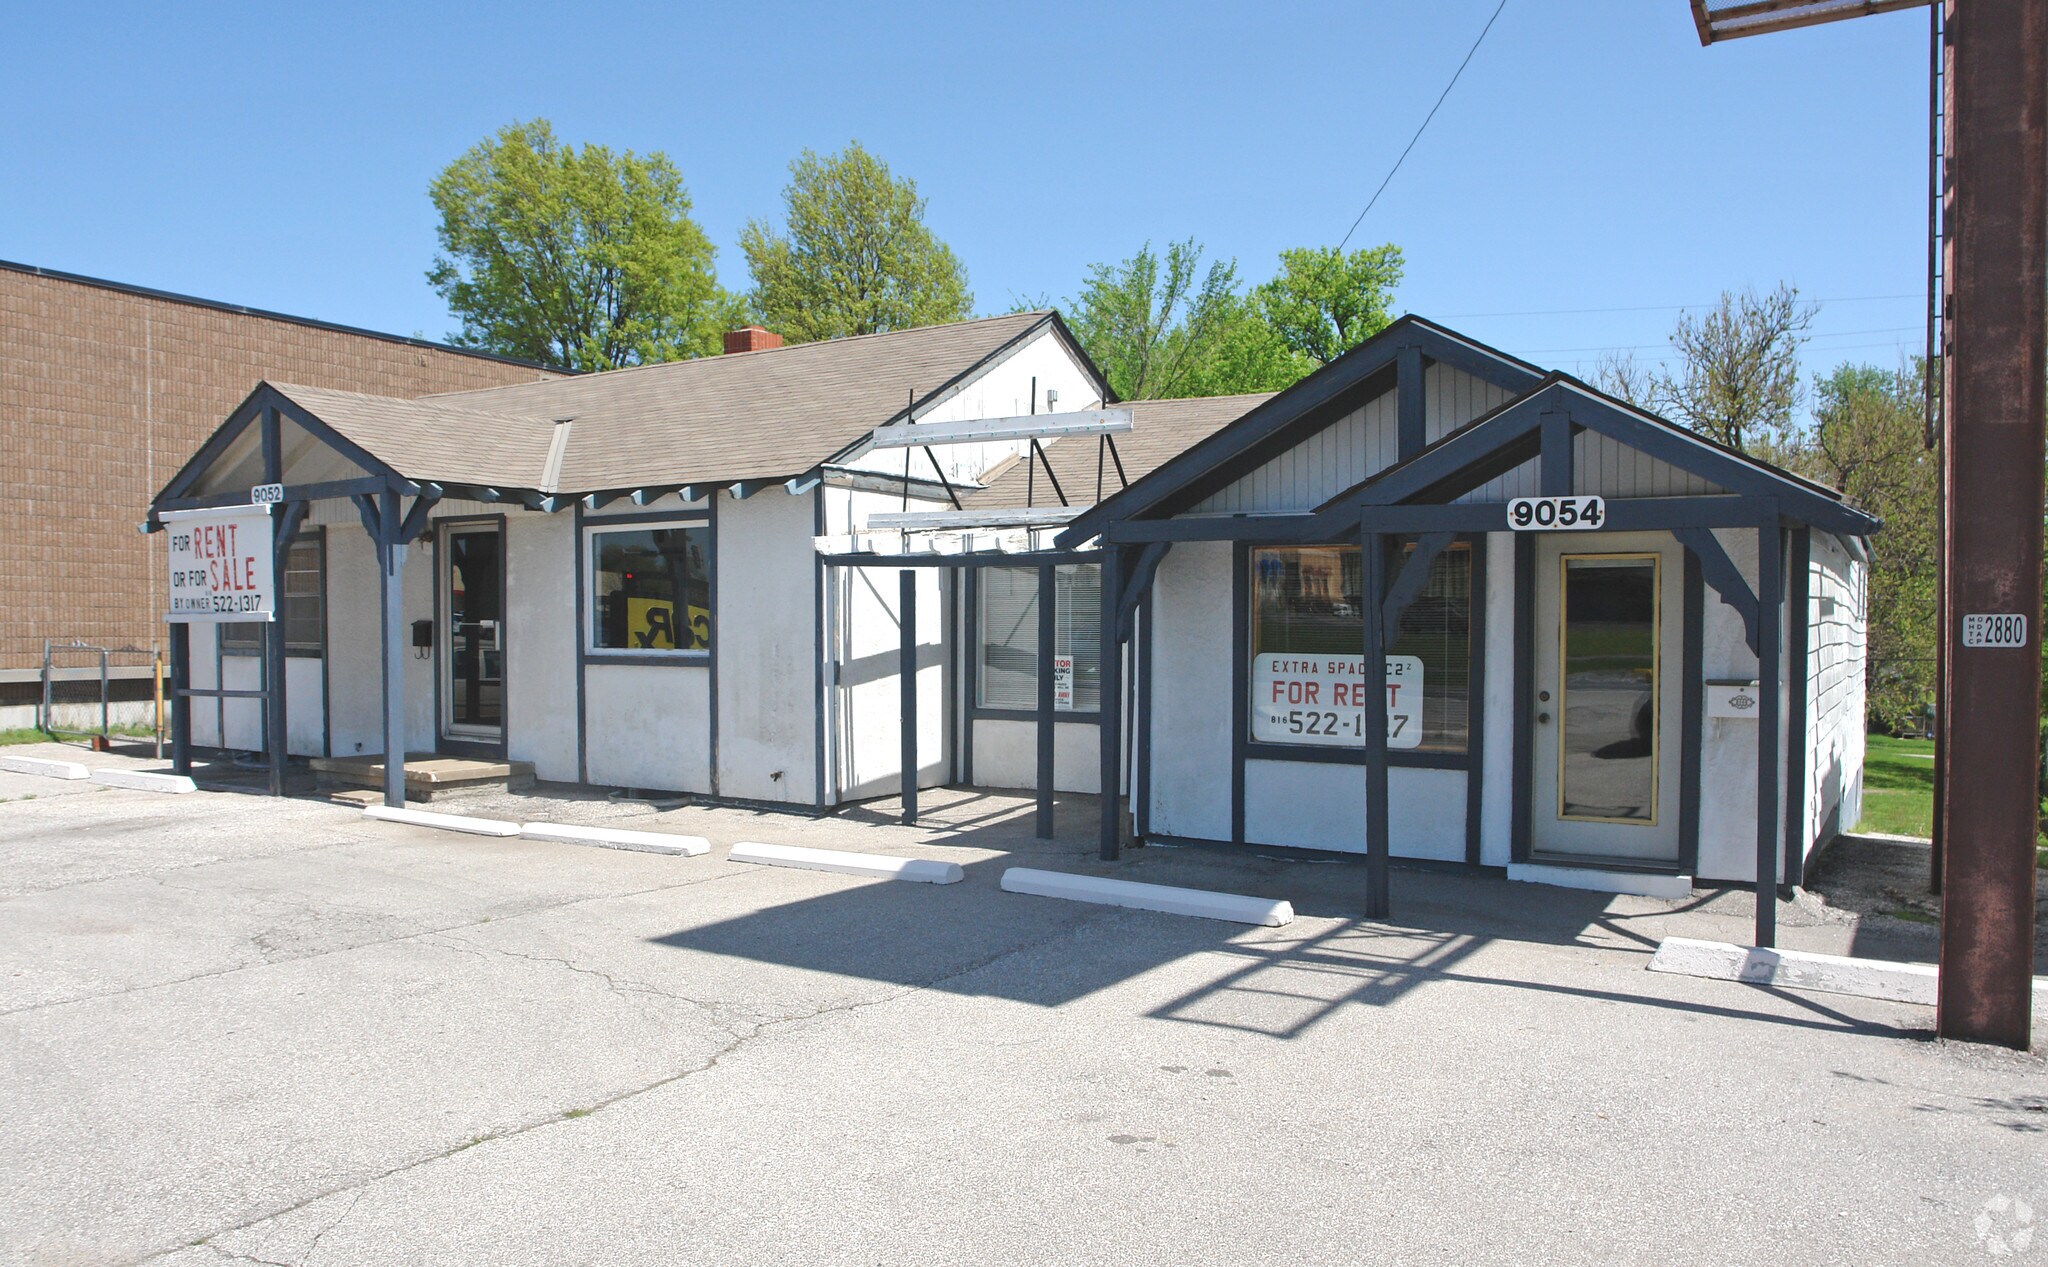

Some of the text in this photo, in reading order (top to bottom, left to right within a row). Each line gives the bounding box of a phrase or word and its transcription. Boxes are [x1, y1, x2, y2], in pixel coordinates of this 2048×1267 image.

[253, 486, 281, 503] 9052
[1514, 499, 1601, 526] 9054
[173, 524, 237, 559] FOR RENT
[173, 557, 256, 592] OR FOR SALE
[174, 594, 261, 613] BY OWNER 522-1317
[1985, 616, 2022, 644] 2880
[1272, 660, 1318, 674] EXTRA
[1328, 661, 1365, 675] SPAC
[1272, 680, 1401, 708] FOR RET
[1271, 710, 1409, 738] 816 522-17
